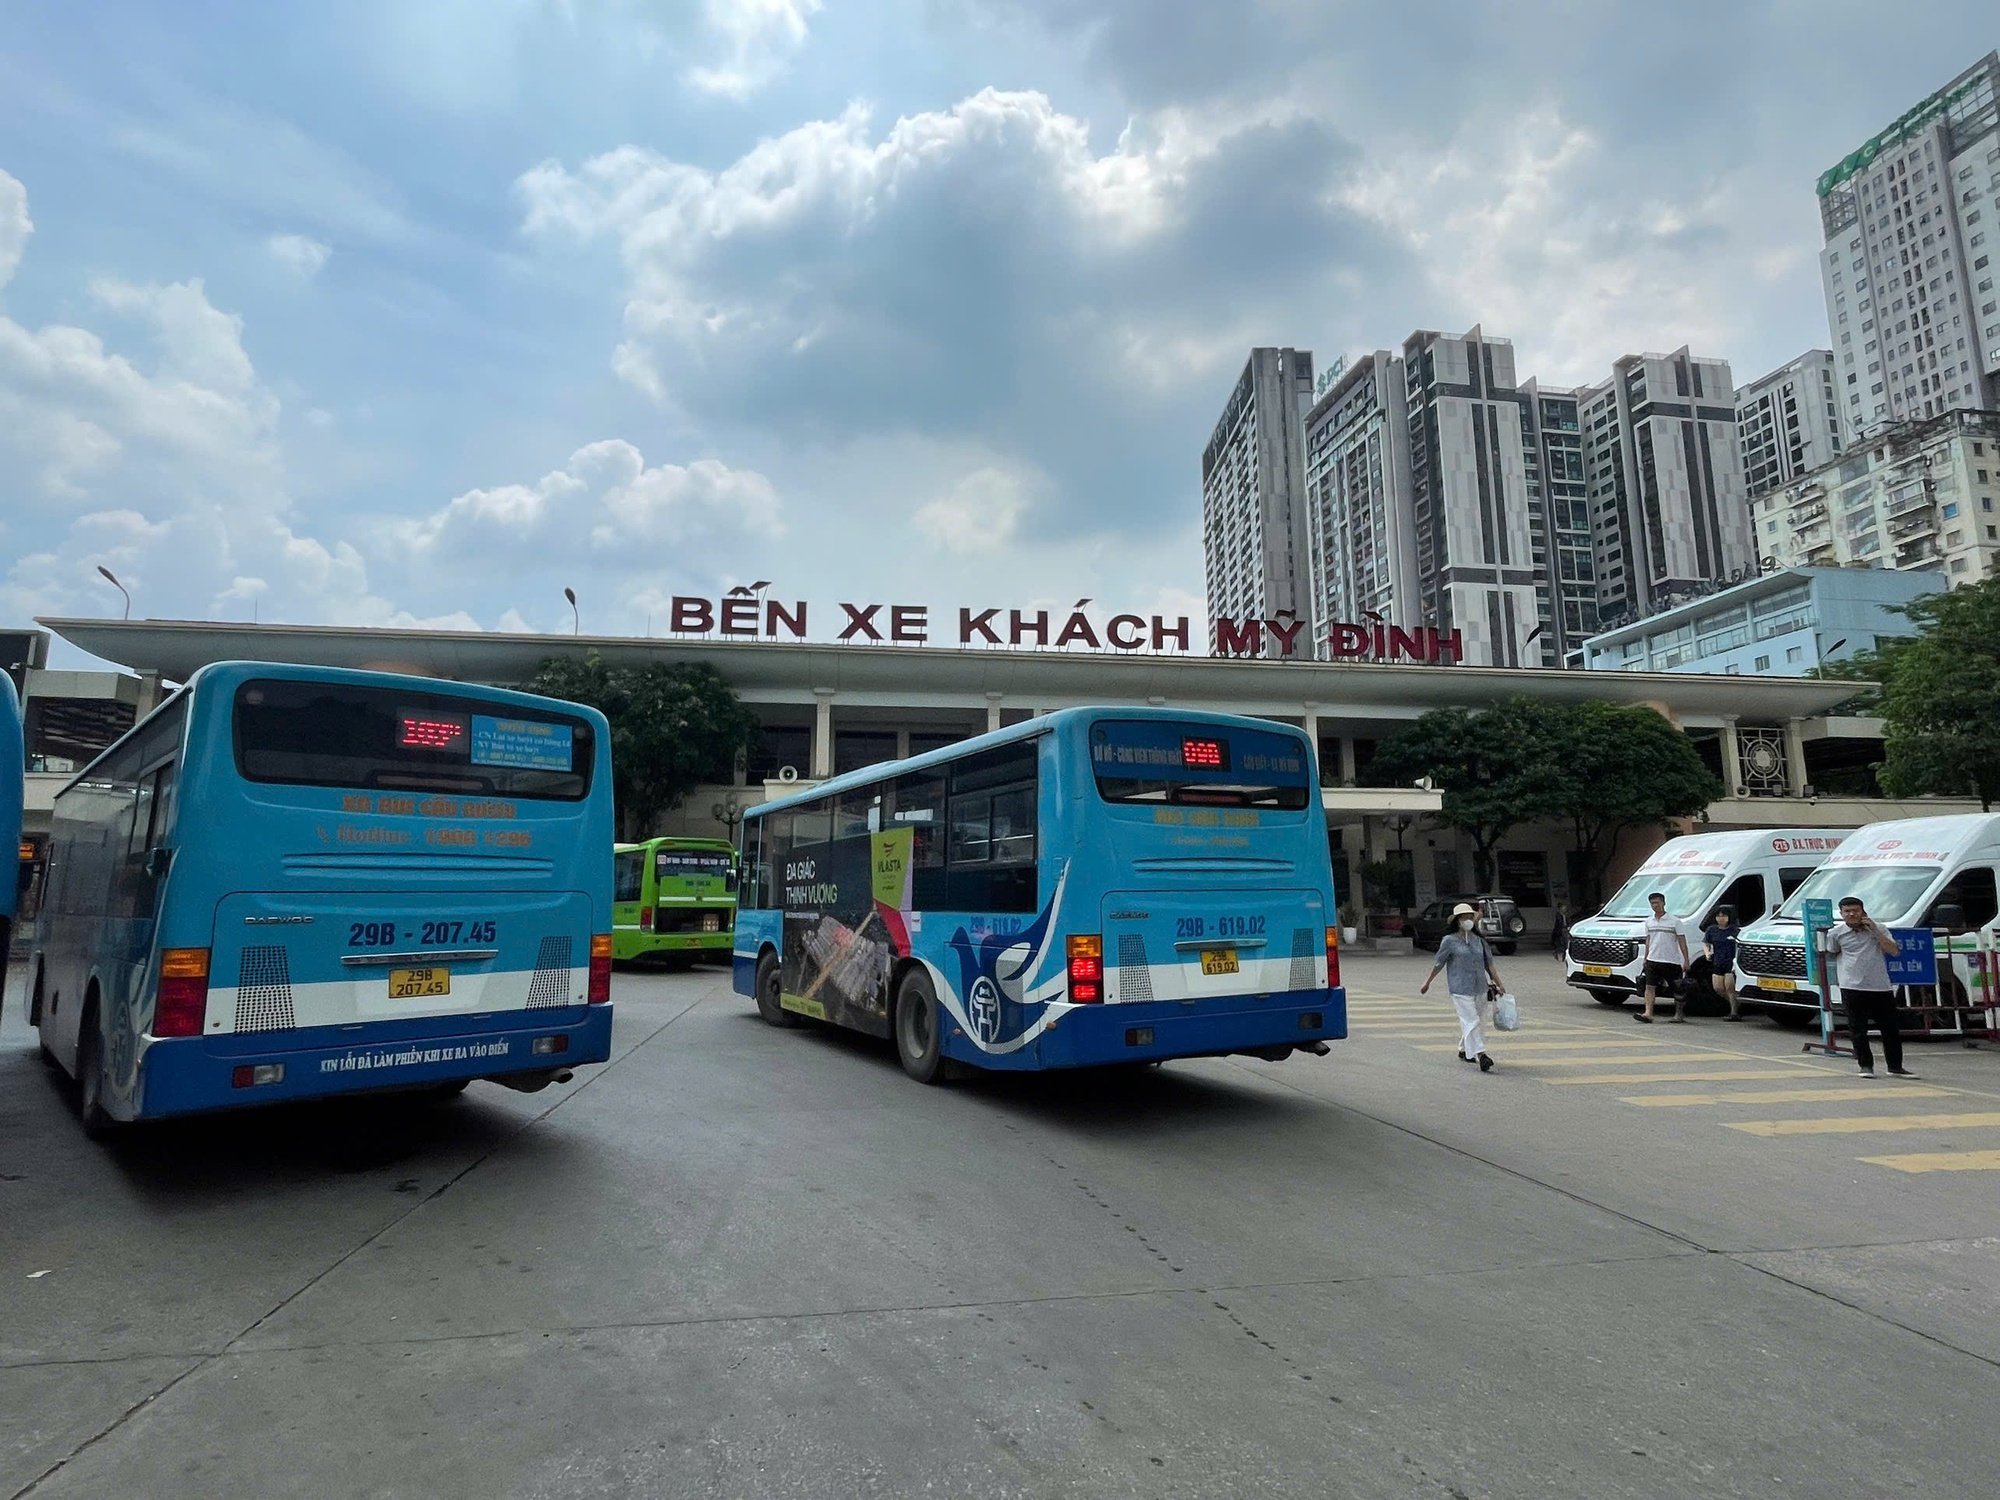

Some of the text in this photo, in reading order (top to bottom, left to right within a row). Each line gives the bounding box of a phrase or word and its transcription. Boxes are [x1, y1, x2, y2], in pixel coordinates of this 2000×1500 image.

[1822, 145, 1875, 188] FLC
[1761, 556, 1777, 572] 9
[671, 581, 1464, 662] BẾN XE KHÁCH MỸ ĐÌNH
[786, 856, 816, 881] ĐA GIÁC
[878, 859, 900, 873] VLASTA
[786, 883, 838, 909] THỊNH VƯỢNG
[348, 923, 395, 946] 29B
[420, 921, 496, 944] 207.45
[1177, 918, 1204, 937] 29B
[1219, 916, 1266, 935] 619.02
[408, 970, 433, 982] 29B
[1207, 961, 1236, 973] 619.02
[397, 983, 443, 996] 207.45
[319, 1059, 338, 1073] XIN
[339, 1051, 356, 1072] LỖI
[357, 1052, 371, 1070] ĐÃ
[374, 1050, 394, 1068] LÀM
[424, 1049, 441, 1063] KHI
[441, 1047, 454, 1061] XE
[455, 1046, 468, 1060] RA
[469, 1042, 488, 1058] VÀO
[487, 1037, 510, 1056] ĐIỂM
